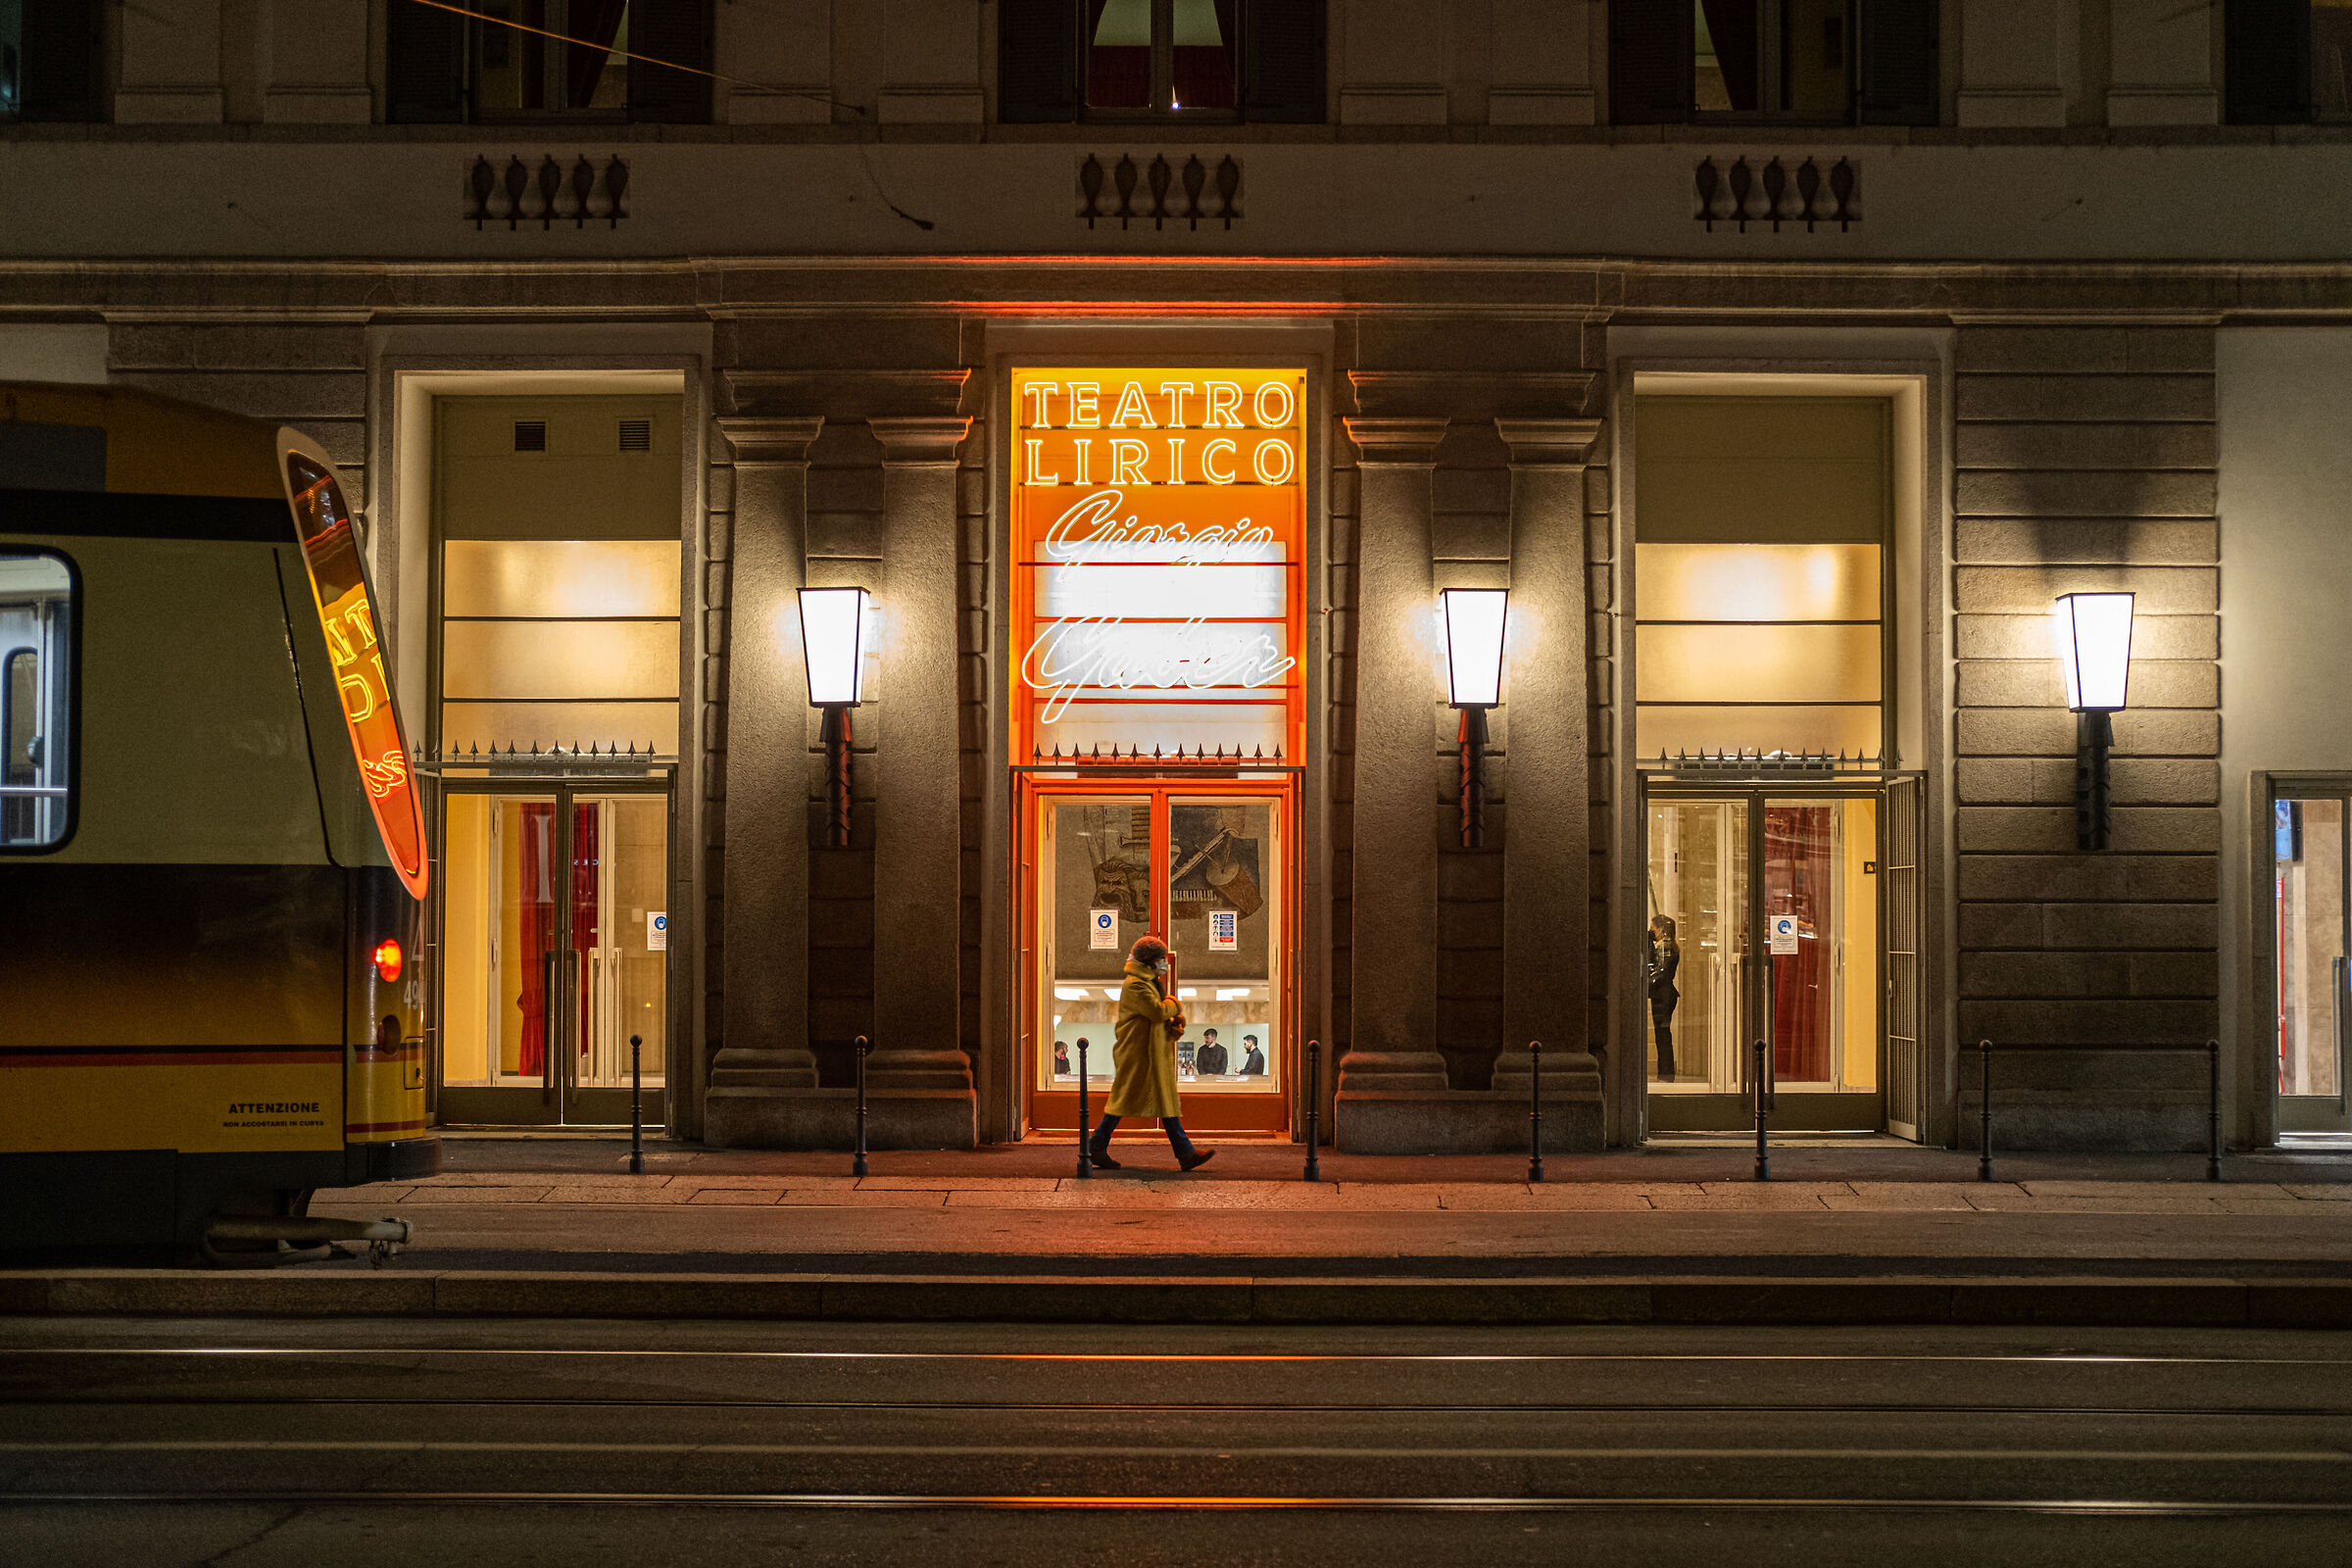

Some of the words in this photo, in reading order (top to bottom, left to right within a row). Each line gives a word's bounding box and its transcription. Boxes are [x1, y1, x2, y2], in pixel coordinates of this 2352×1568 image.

[1024, 380, 1295, 429] TEATRO
[1024, 438, 1295, 486] LIRICO
[228, 1102, 320, 1114] ATTENZIONE
